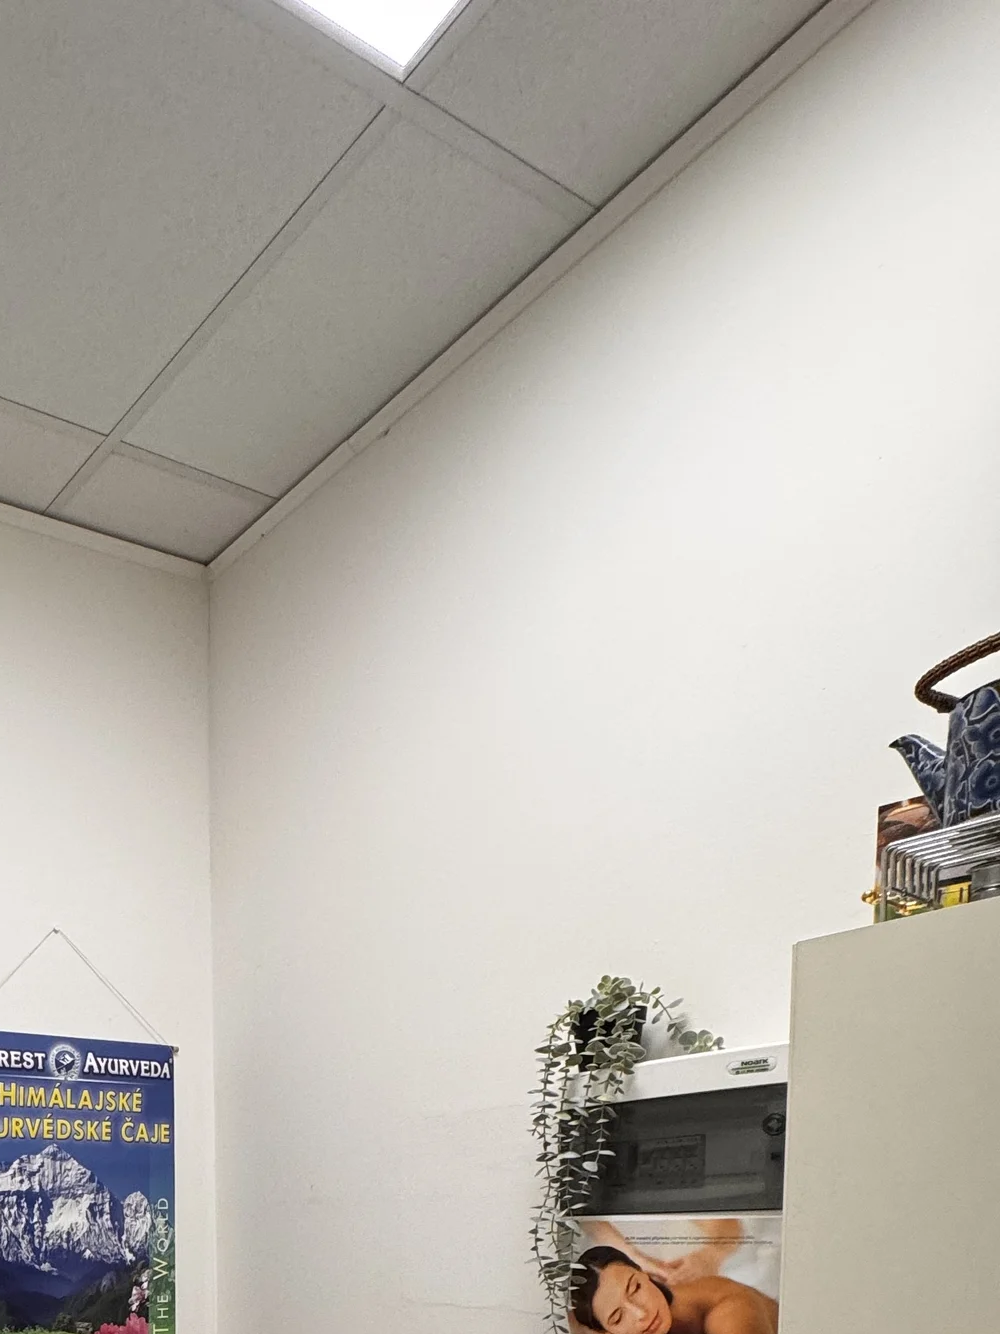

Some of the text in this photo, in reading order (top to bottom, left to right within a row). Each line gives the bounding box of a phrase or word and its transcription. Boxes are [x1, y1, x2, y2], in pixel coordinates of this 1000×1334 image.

[83, 1052, 171, 1079] AYURVEDA
[121, 1113, 170, 1143] ČAJE
[152, 1197, 169, 1281] WORLD
